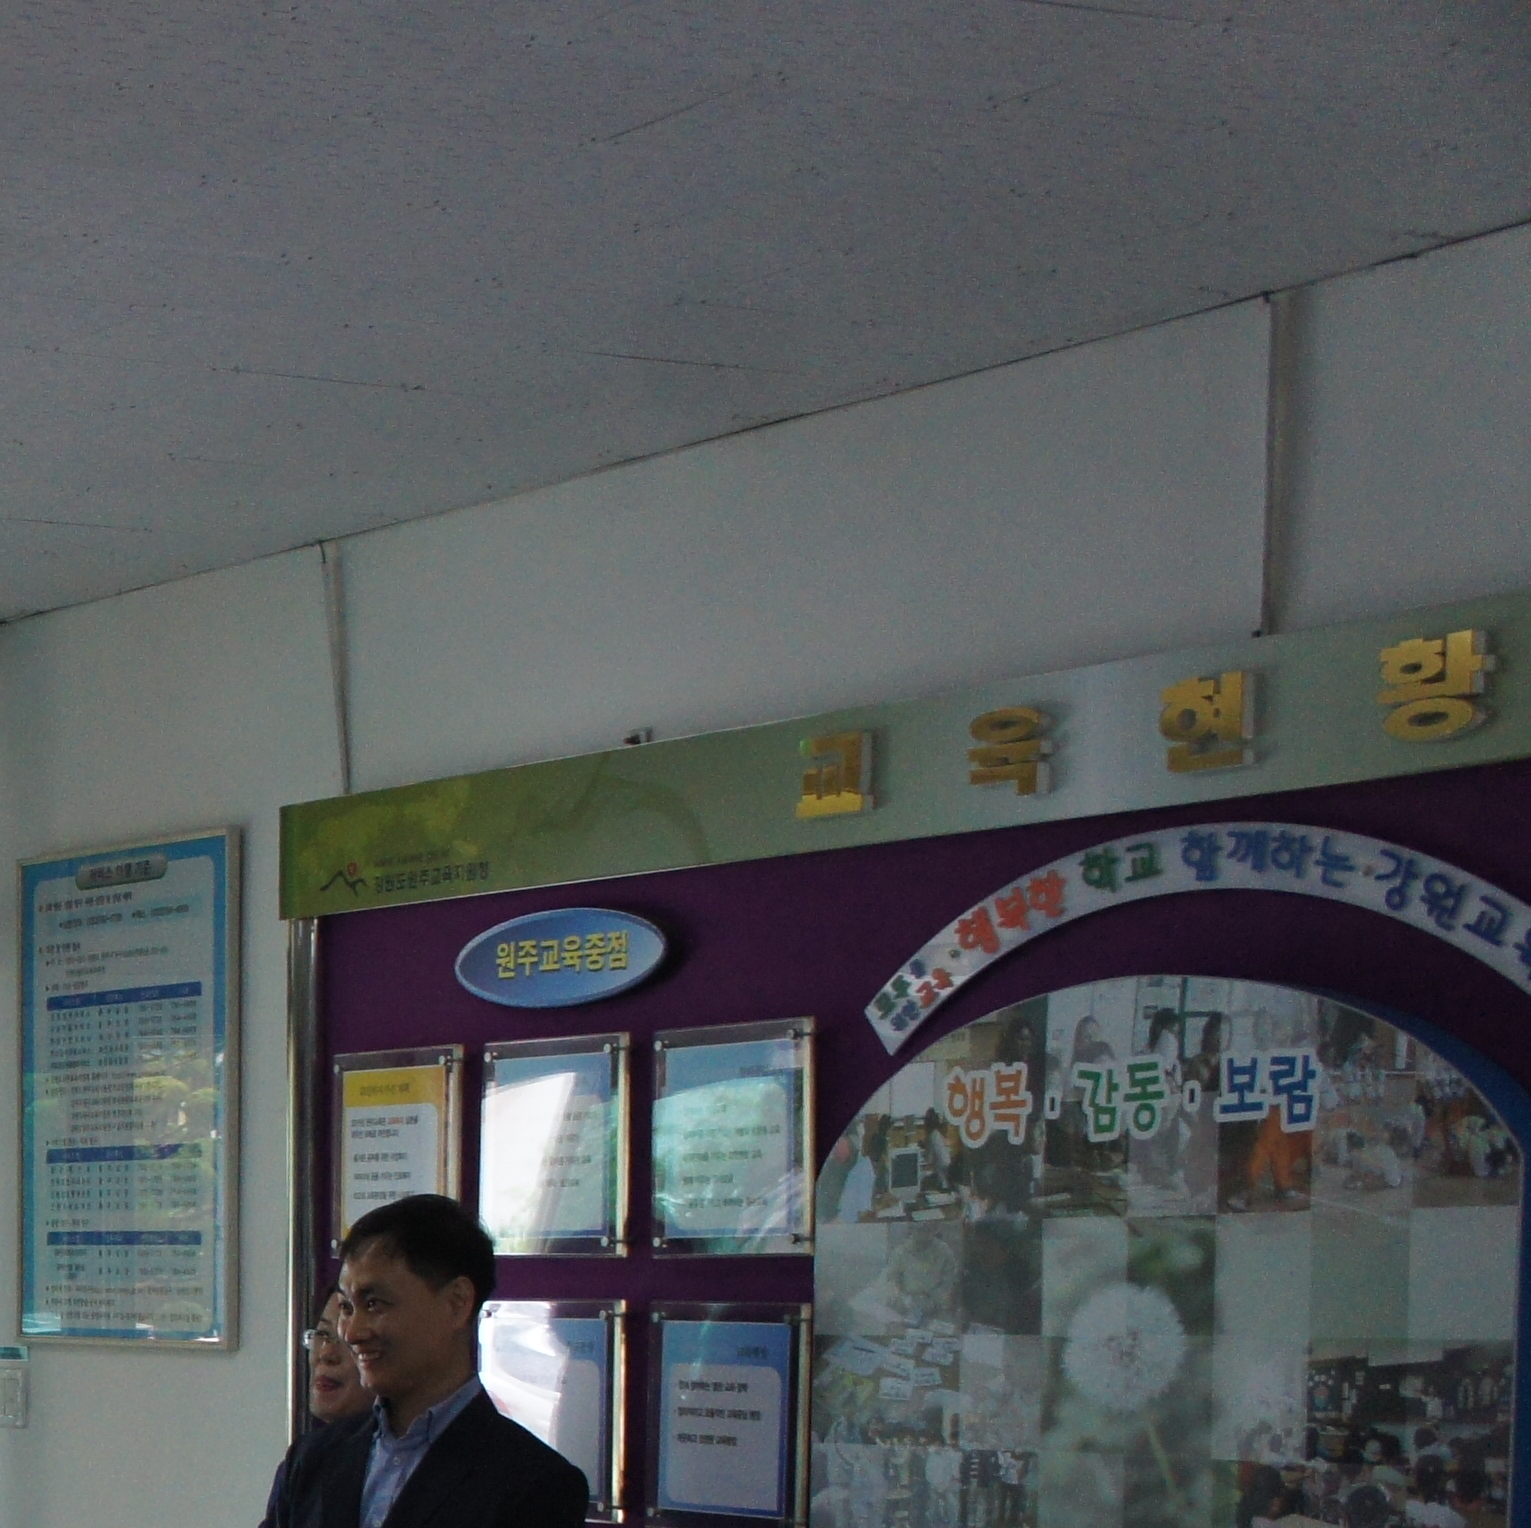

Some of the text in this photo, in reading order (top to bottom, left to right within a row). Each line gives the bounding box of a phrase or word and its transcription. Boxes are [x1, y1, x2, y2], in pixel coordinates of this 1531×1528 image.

[1079, 842, 1163, 892] 학교
[1181, 829, 1357, 889] 함께하는
[495, 930, 630, 979] 원주교육중점
[946, 1054, 1316, 1142] 행복 감동 보람
